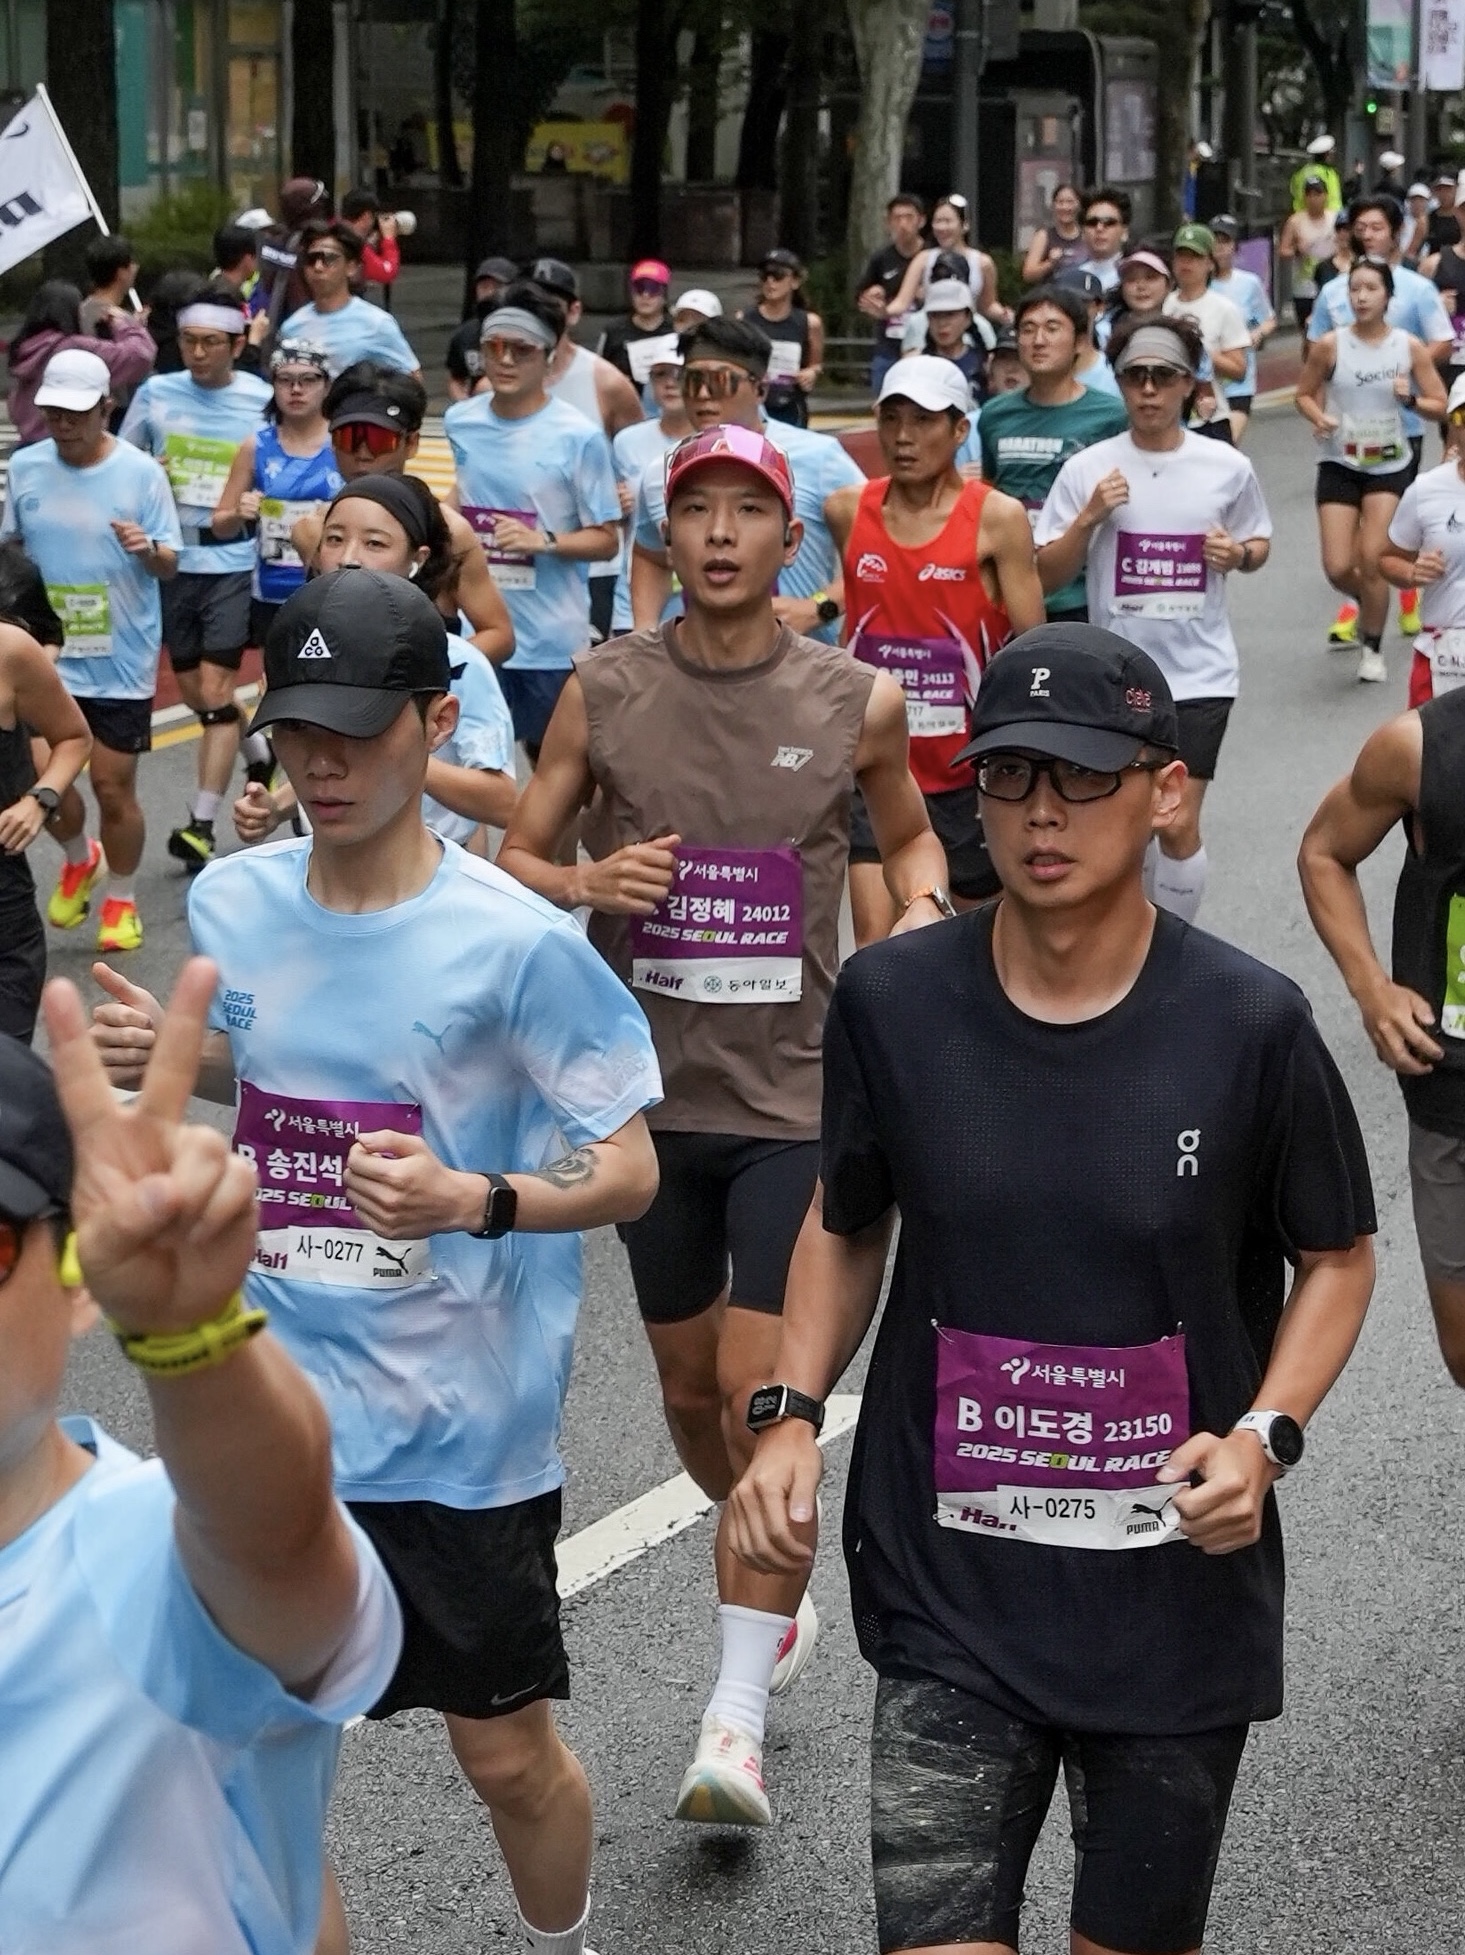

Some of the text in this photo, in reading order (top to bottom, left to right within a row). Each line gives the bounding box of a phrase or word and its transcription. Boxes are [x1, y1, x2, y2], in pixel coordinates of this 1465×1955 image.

[1121, 558, 1133, 573] C
[1031, 667, 1051, 690] P
[693, 863, 759, 883] 서울특별시
[667, 895, 791, 925] 김정혜 24012
[642, 921, 789, 945] 2025 SEOUL RACE
[645, 970, 684, 991] Half
[727, 978, 788, 992] 동아일보
[224, 989, 256, 1005] 2025
[222, 1001, 257, 1019] SEOUL
[288, 1115, 360, 1139] 서울특별시
[266, 1148, 344, 1187] 송진석
[254, 1186, 352, 1211] 025 SEOUL
[296, 1235, 364, 1263] 사-0277
[372, 1267, 403, 1278] PUMA
[1031, 1364, 1126, 1389] 서울특별시
[957, 1396, 1173, 1445] B 이도경 23150
[956, 1441, 1172, 1474] 2025 SEOUL RACE
[960, 1505, 1018, 1532] Ha
[1010, 1496, 1096, 1520] 사-0275
[1126, 1520, 1160, 1536] PUMA
